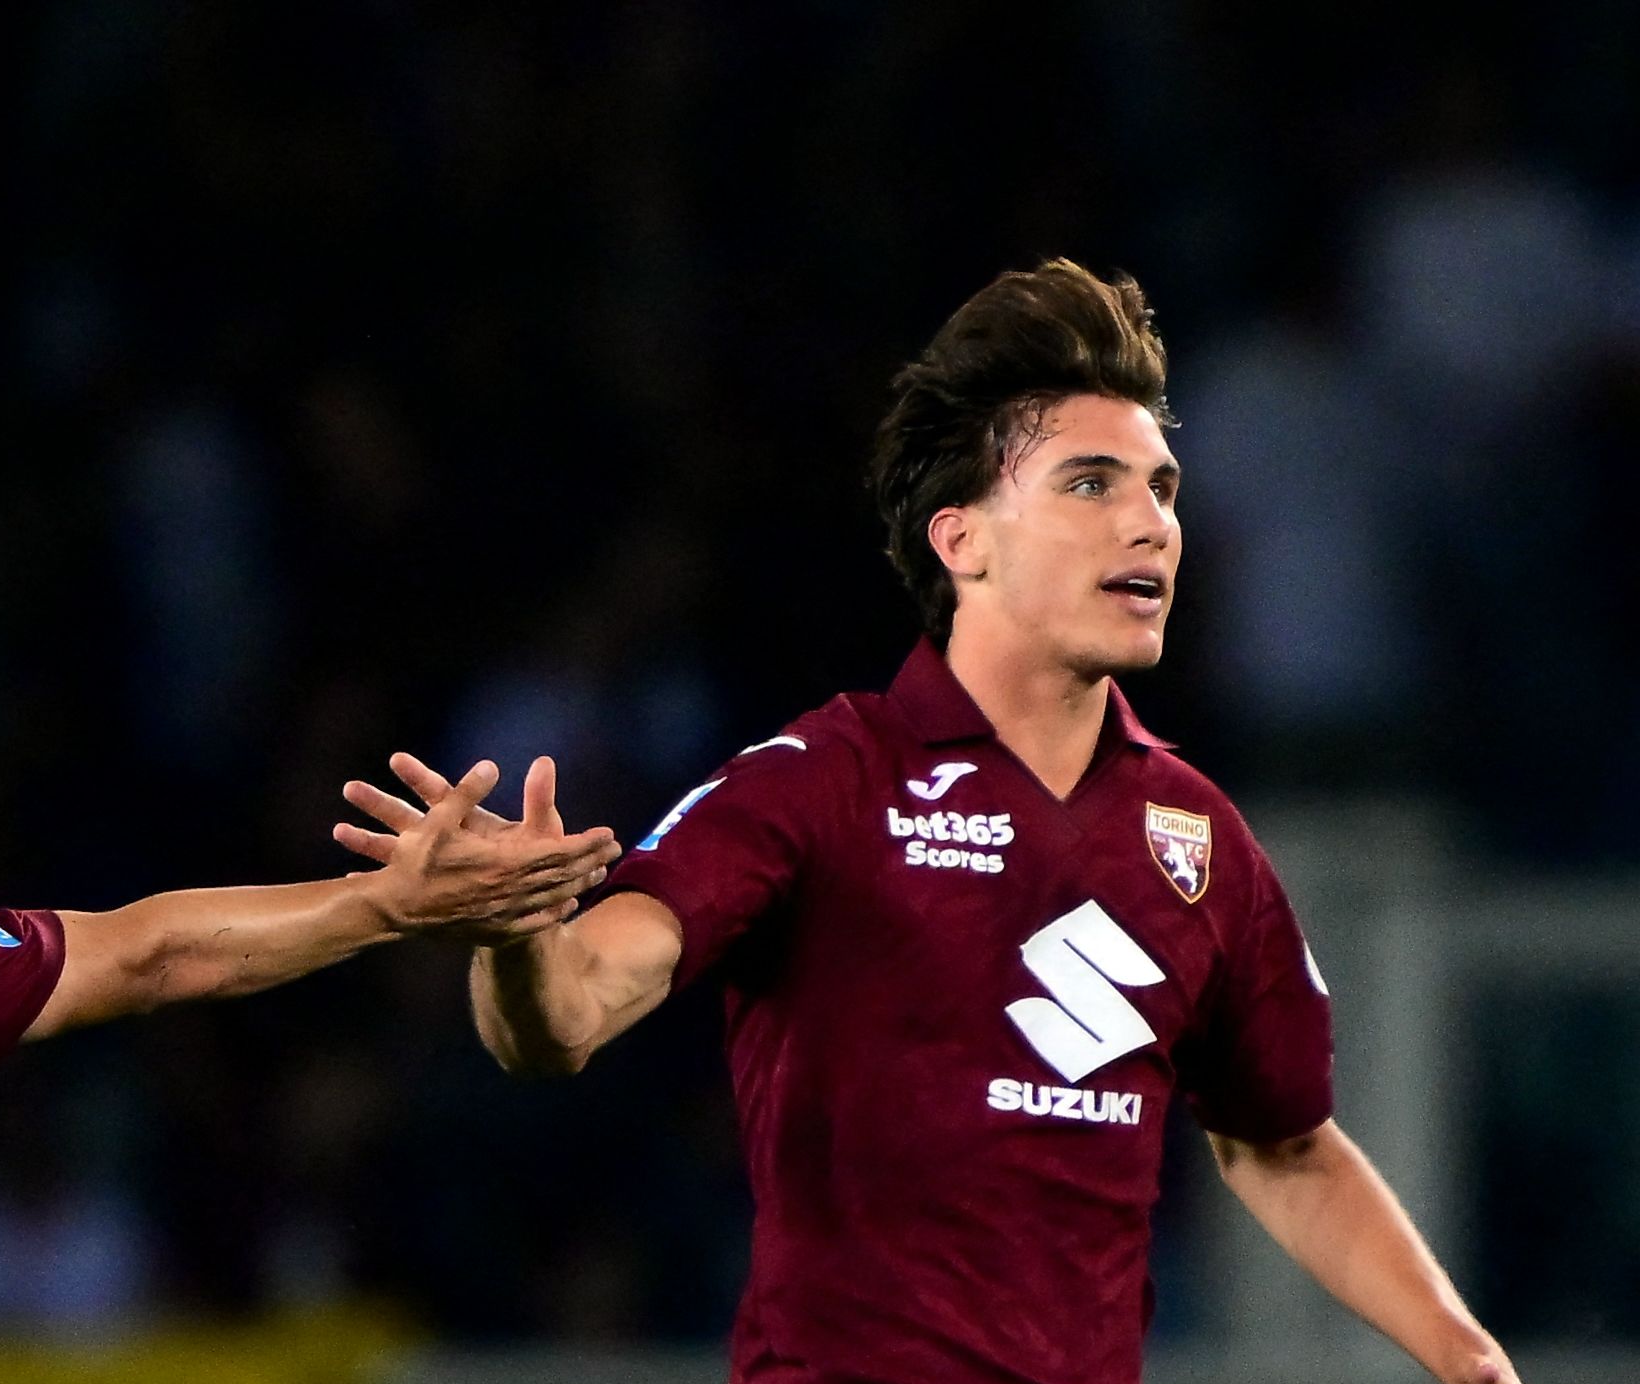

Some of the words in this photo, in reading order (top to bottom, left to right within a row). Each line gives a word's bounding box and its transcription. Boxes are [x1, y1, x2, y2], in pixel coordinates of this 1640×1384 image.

[887, 806, 1015, 846] bet365
[1153, 811, 1205, 838] TORINO
[905, 840, 1005, 874] Scores
[1186, 842, 1205, 859] FC
[986, 1077, 1143, 1125] SUZUKI
